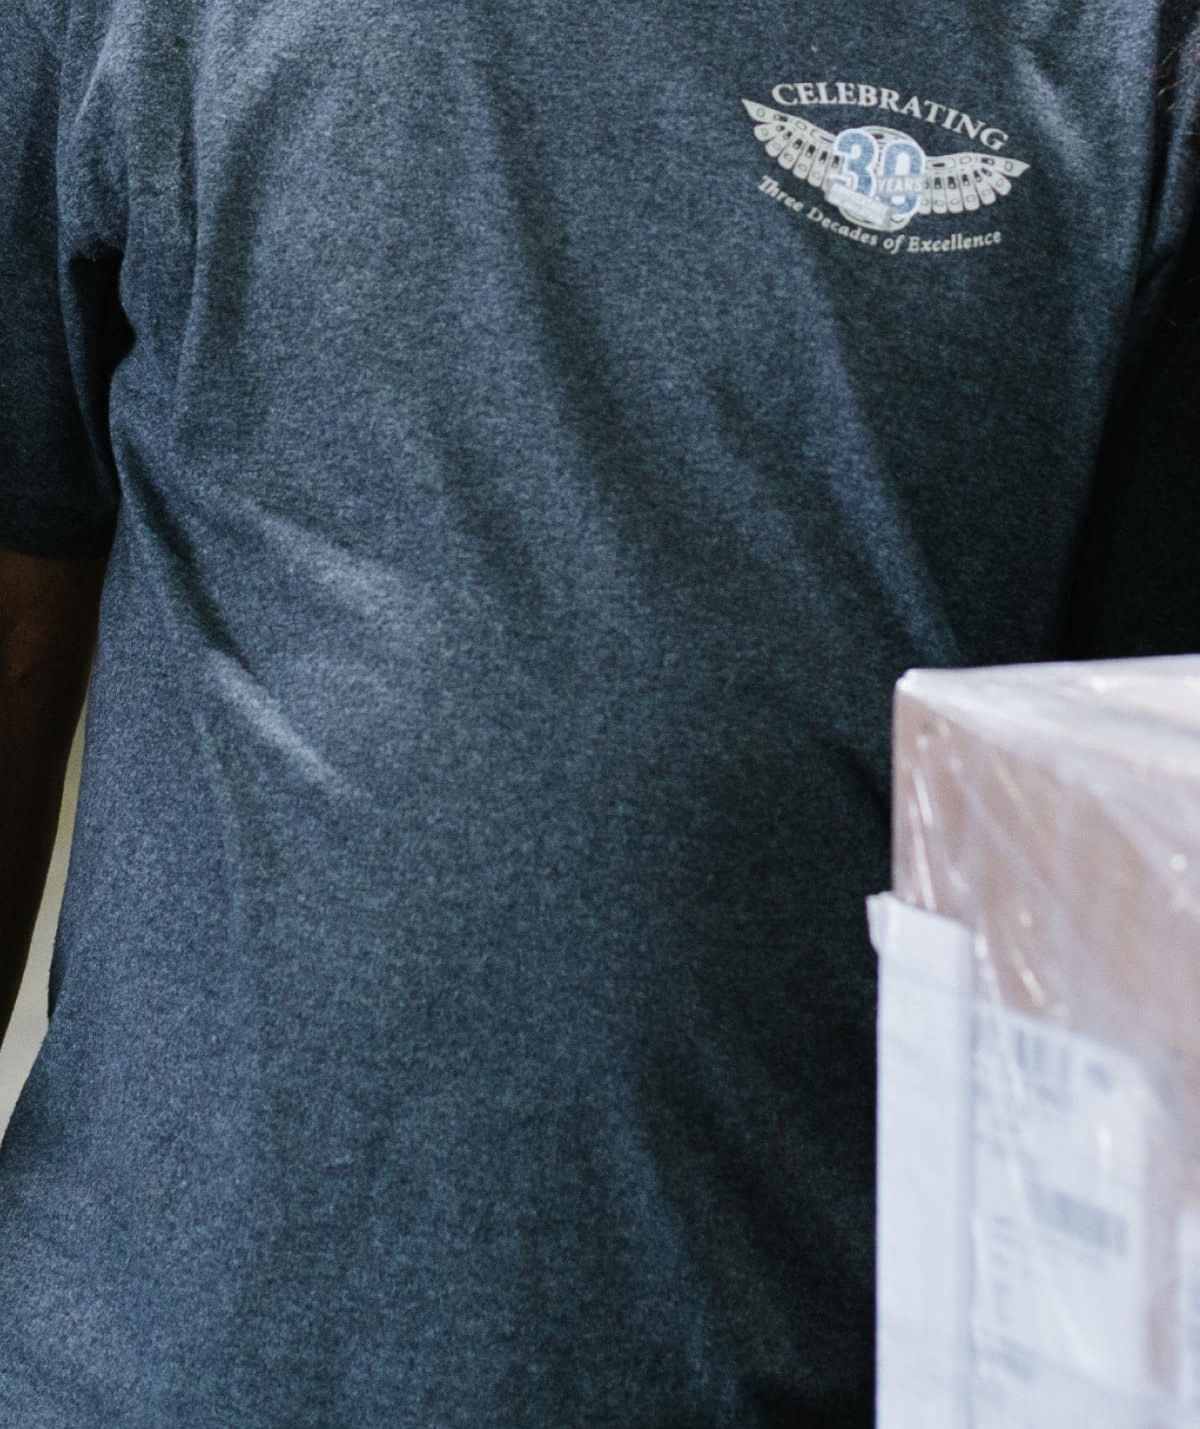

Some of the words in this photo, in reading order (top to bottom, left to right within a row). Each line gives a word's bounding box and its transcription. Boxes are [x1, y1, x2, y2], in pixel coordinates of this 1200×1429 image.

[772, 82, 1009, 150] CELEBRATING
[833, 127, 926, 219] 30
[877, 176, 923, 193] YEARS
[758, 175, 802, 213] Three
[807, 206, 877, 246] Decades
[883, 235, 905, 255] of
[908, 231, 1001, 253] Excellence
